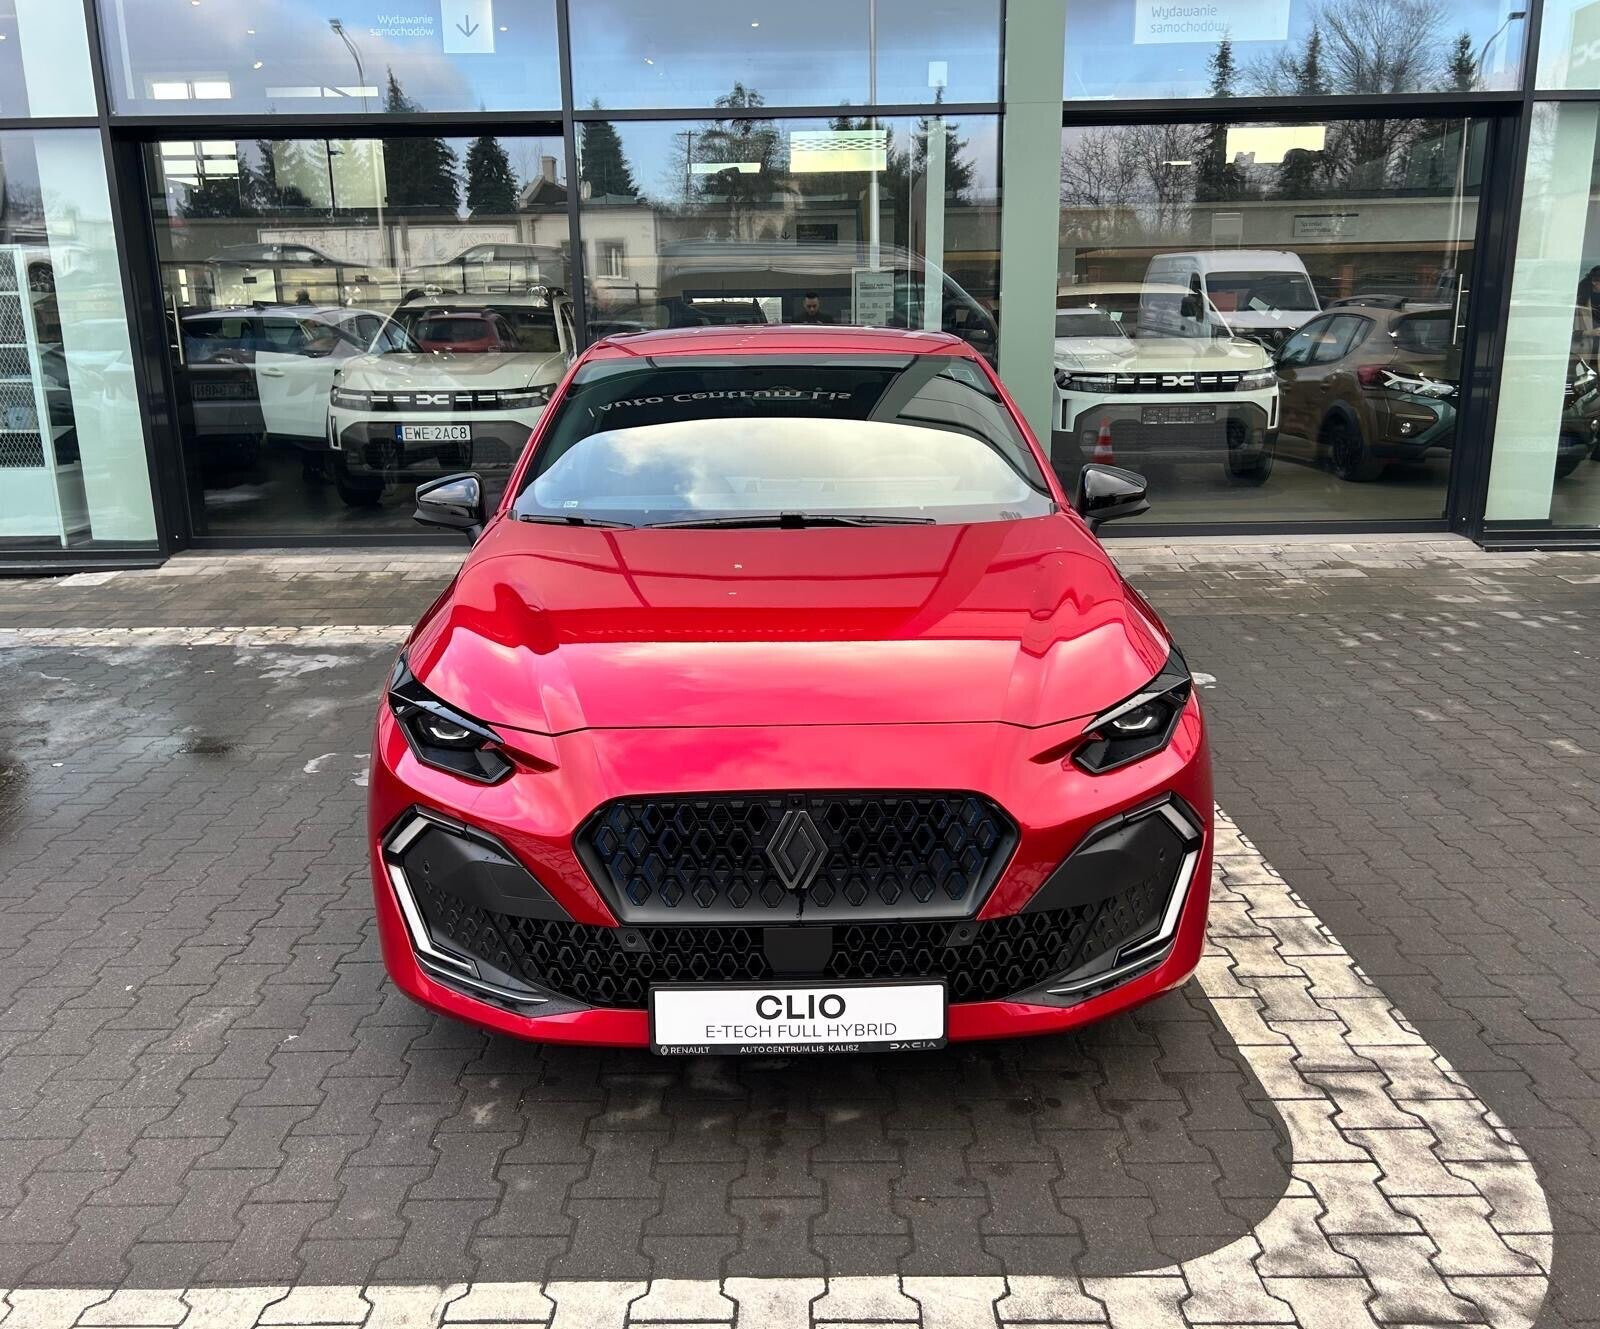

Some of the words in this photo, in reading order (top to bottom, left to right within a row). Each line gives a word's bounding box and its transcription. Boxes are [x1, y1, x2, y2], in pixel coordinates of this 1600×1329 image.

[1150, 4, 1218, 20] Wydawanie
[377, 14, 434, 25] Wydawanie
[369, 25, 434, 37] samochodów
[1150, 20, 1226, 34] samochodów
[404, 427, 430, 440] EWE
[434, 426, 468, 440] 2AC8
[755, 993, 847, 1021] CLIO
[705, 1024, 772, 1039] E-TECH
[777, 1023, 823, 1038] FULL
[826, 1022, 898, 1037] HYBRID
[670, 1045, 711, 1055] RENAULT
[828, 1043, 860, 1053] KALISZ
[889, 1041, 937, 1050] DACIA
